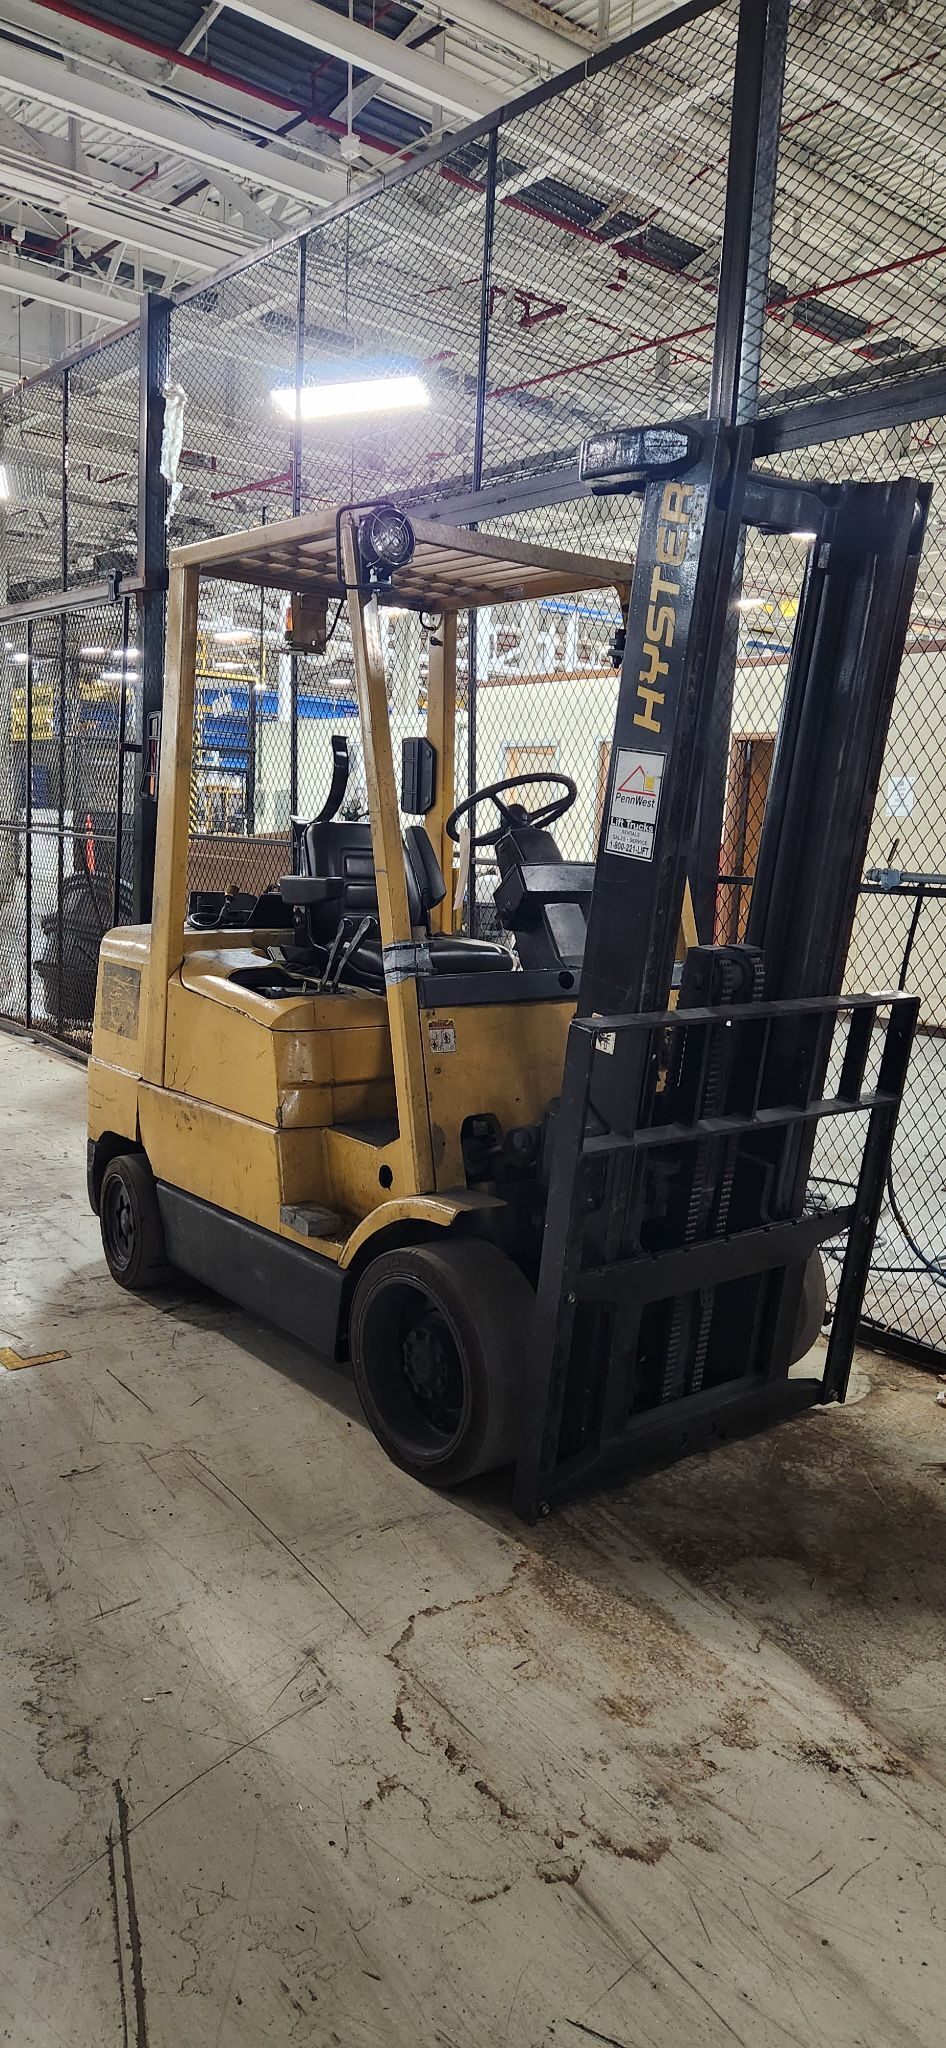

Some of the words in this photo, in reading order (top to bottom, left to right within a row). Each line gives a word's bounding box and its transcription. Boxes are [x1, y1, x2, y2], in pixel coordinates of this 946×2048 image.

[633, 481, 694, 734] HYSTER
[615, 792, 655, 808] PennWest
[611, 816, 625, 828] Lift
[627, 820, 654, 833] Trucks
[609, 840, 650, 856] 1-800-221-LIFT
